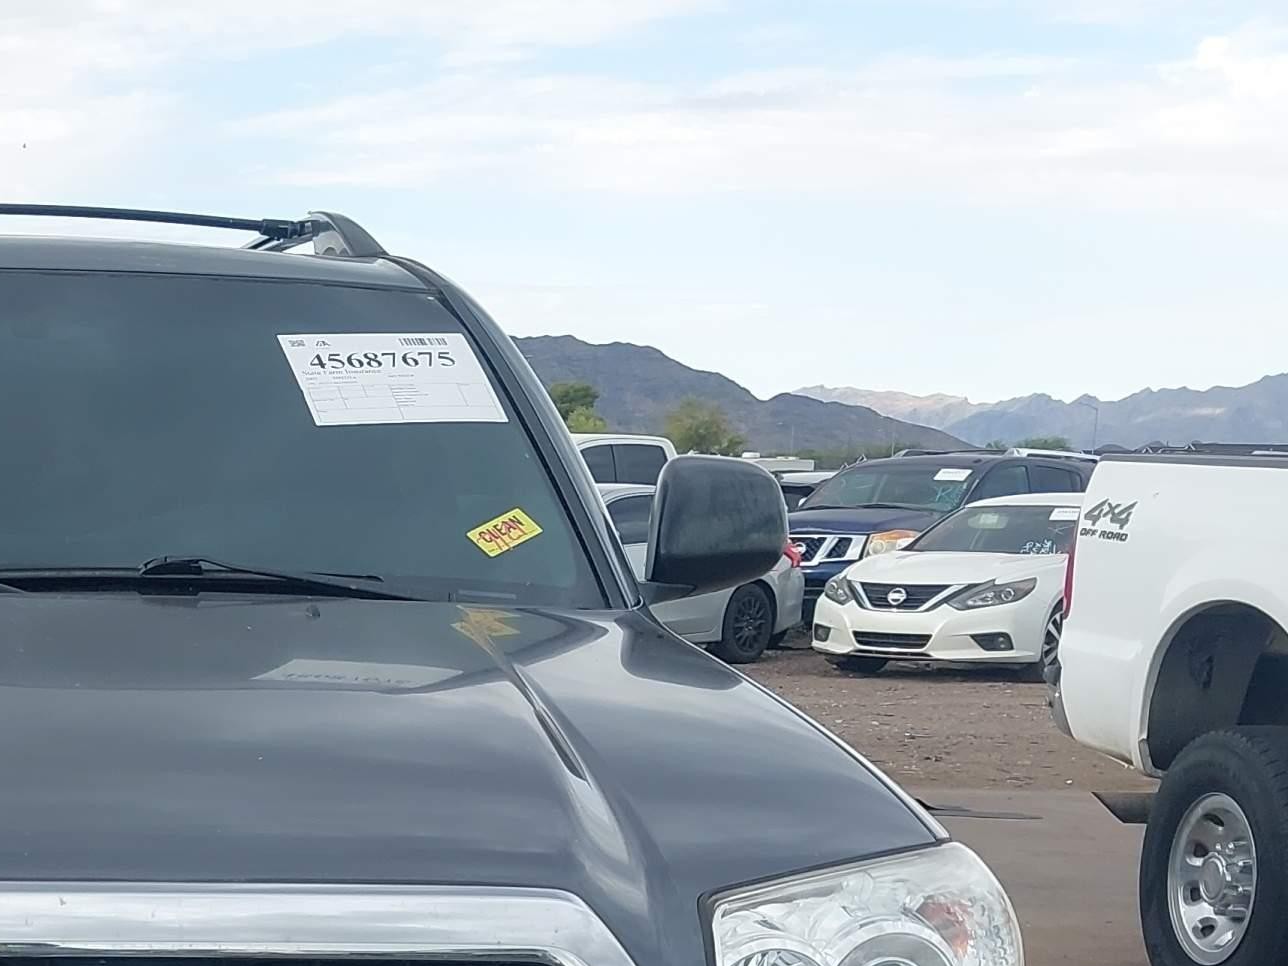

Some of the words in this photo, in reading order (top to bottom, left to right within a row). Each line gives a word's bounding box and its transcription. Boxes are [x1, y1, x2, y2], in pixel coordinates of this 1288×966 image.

[309, 351, 456, 370] 45687675
[1079, 527, 1098, 537] OFF
[1098, 530, 1129, 542] ROAD
